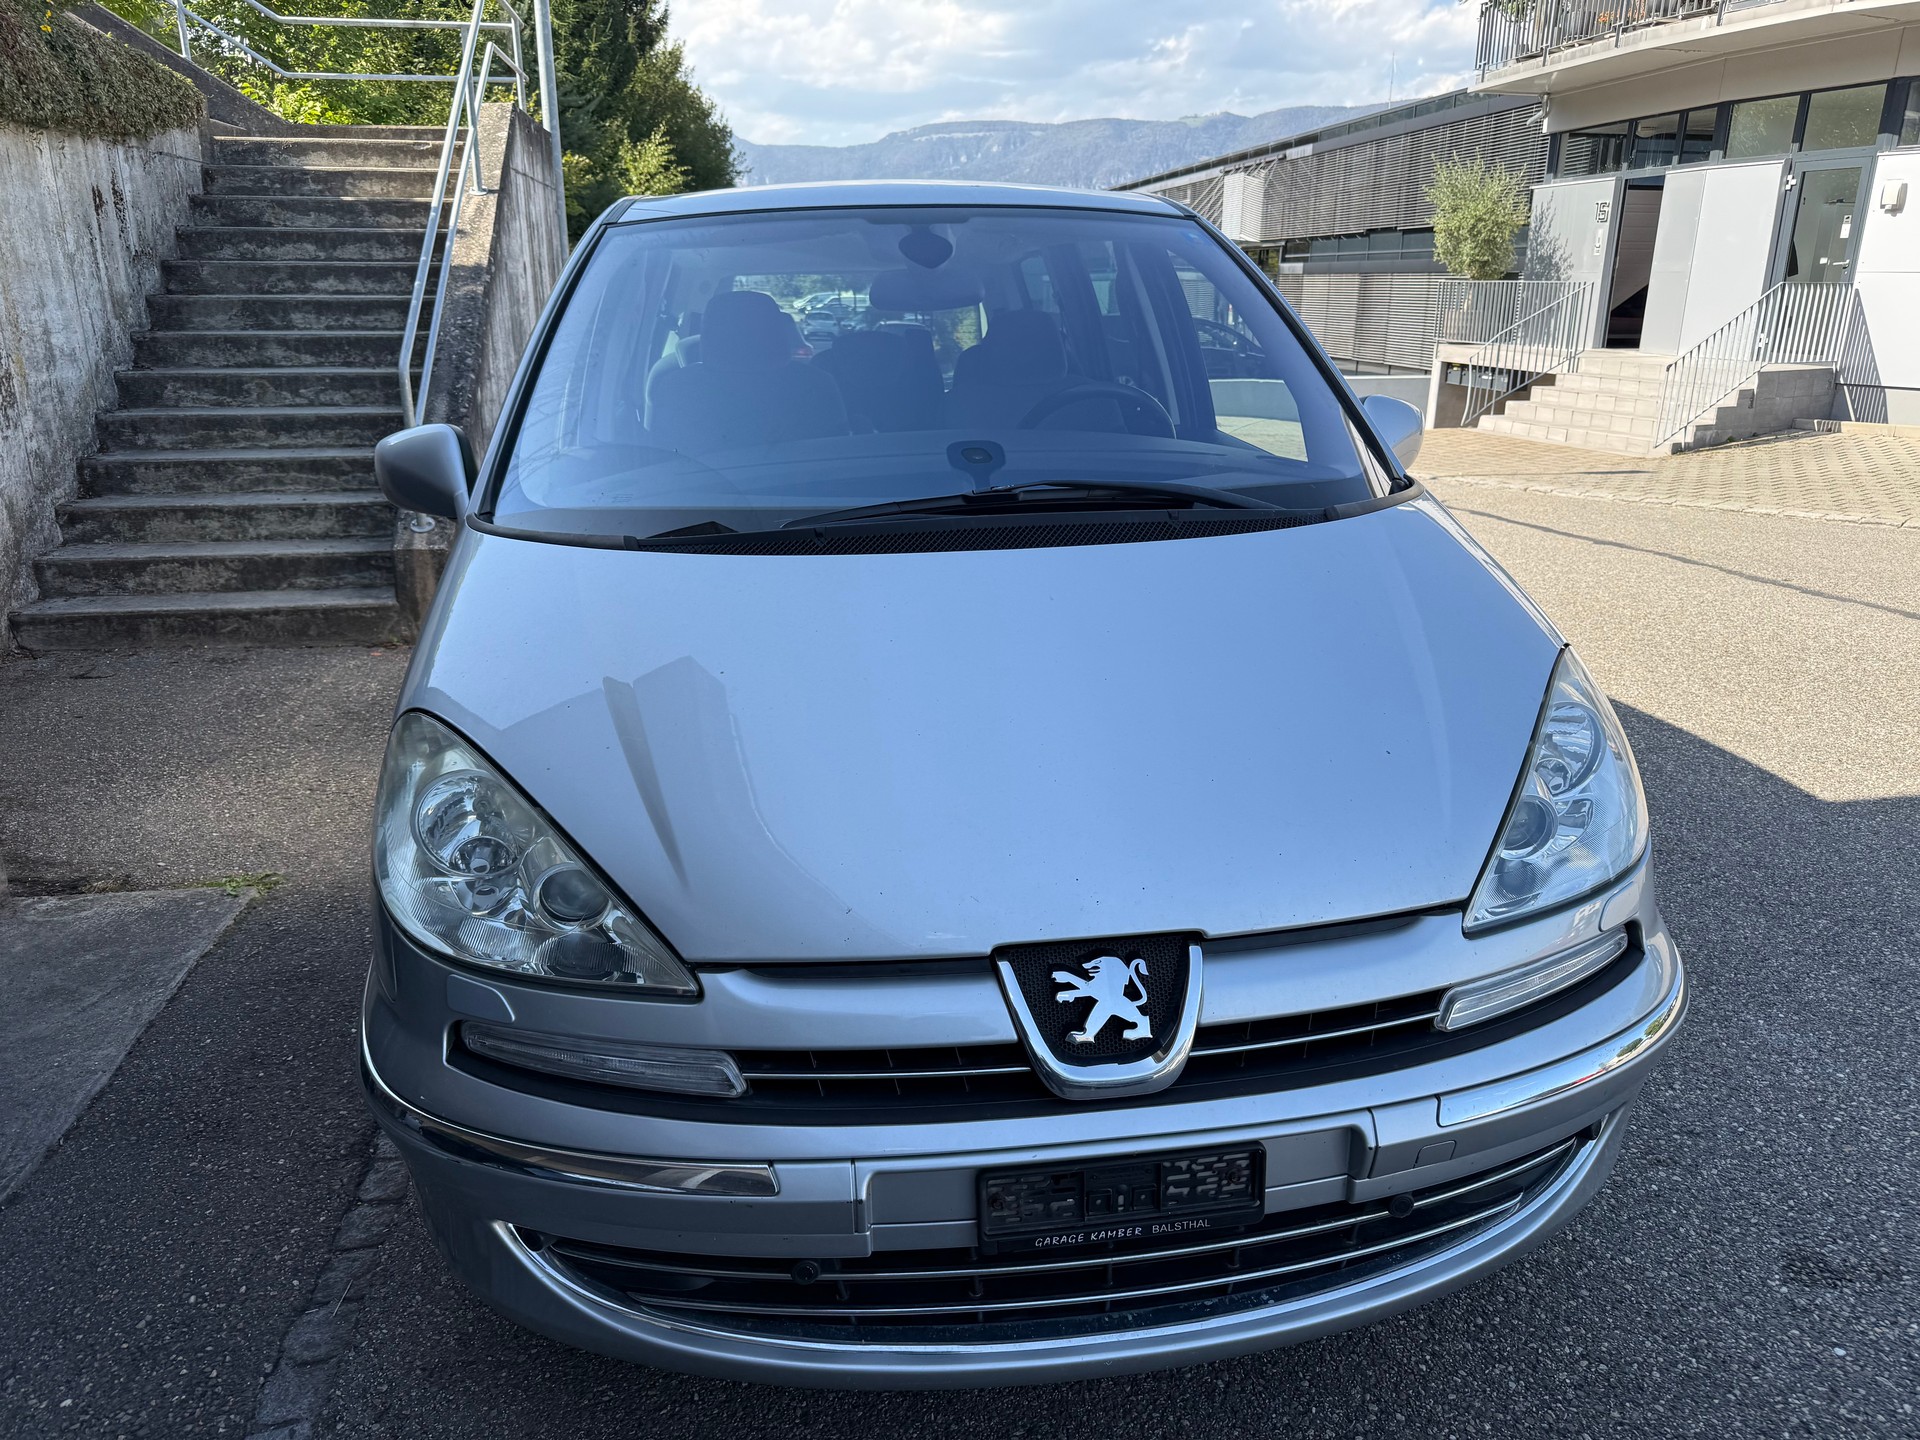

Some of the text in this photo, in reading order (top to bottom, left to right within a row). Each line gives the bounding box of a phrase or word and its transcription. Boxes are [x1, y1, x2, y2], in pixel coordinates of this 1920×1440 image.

[1595, 202, 1610, 223] 15
[1035, 1219, 1211, 1248] GARAGE KAMBER BALSTHAL
